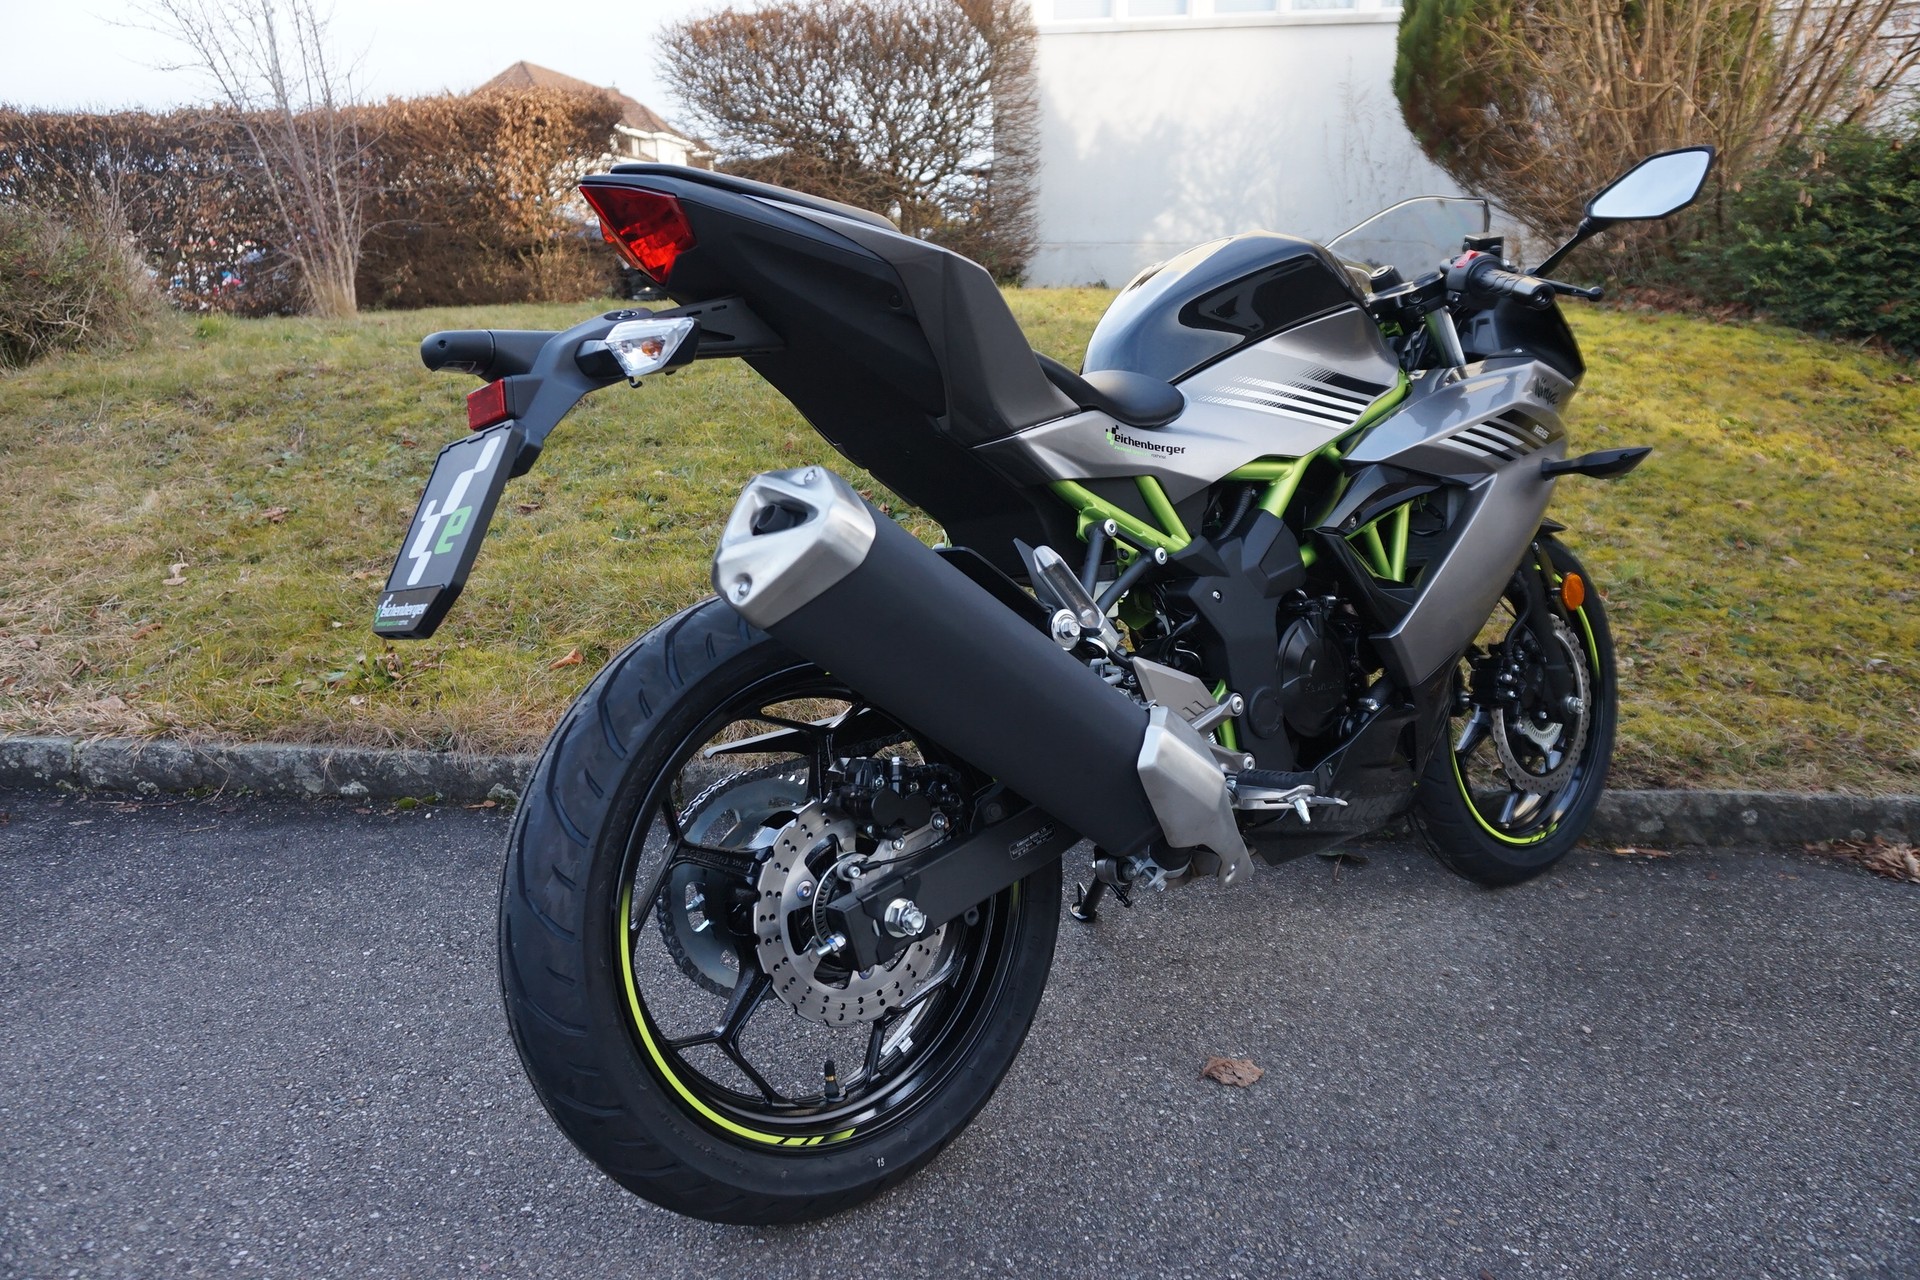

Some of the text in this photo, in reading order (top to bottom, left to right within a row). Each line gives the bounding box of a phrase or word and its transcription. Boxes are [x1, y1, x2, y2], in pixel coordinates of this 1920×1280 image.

[1533, 424, 1550, 440] 125
[1114, 433, 1186, 456] eichenberger
[1321, 790, 1406, 822] Kawas
[876, 1157, 885, 1168] 15
